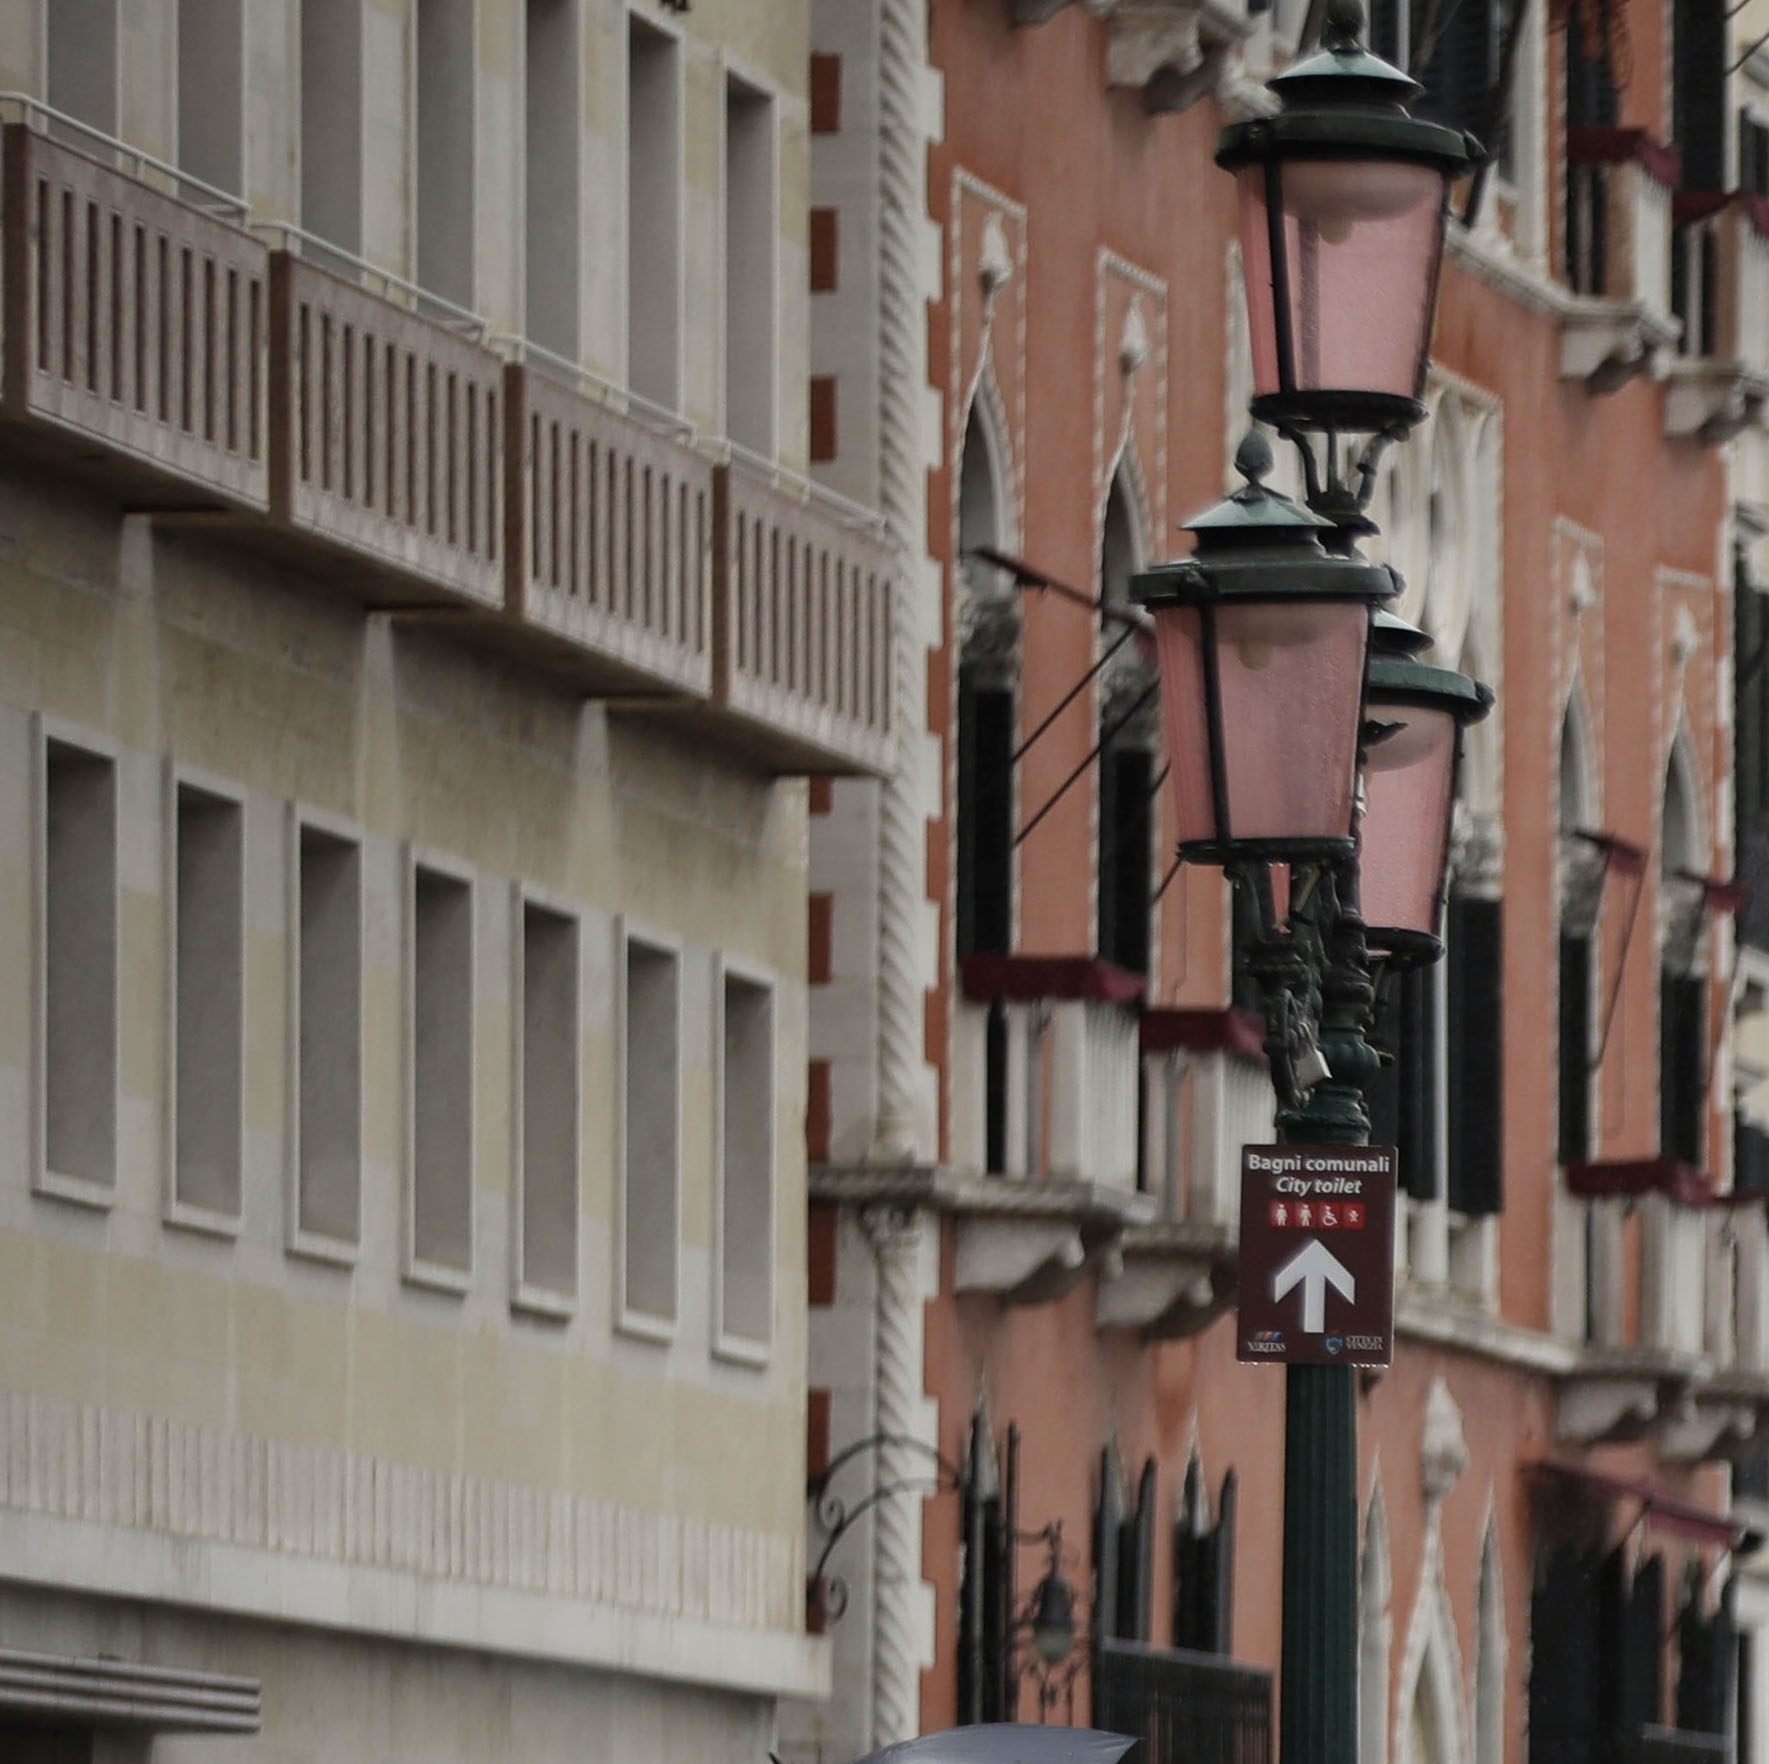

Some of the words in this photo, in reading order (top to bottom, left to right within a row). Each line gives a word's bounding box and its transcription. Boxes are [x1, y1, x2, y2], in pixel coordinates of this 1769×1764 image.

[1249, 1154, 1301, 1174] Bagni
[1305, 1156, 1390, 1173] comunali
[1276, 1177, 1312, 1196] City
[1314, 1177, 1362, 1194] toilet
